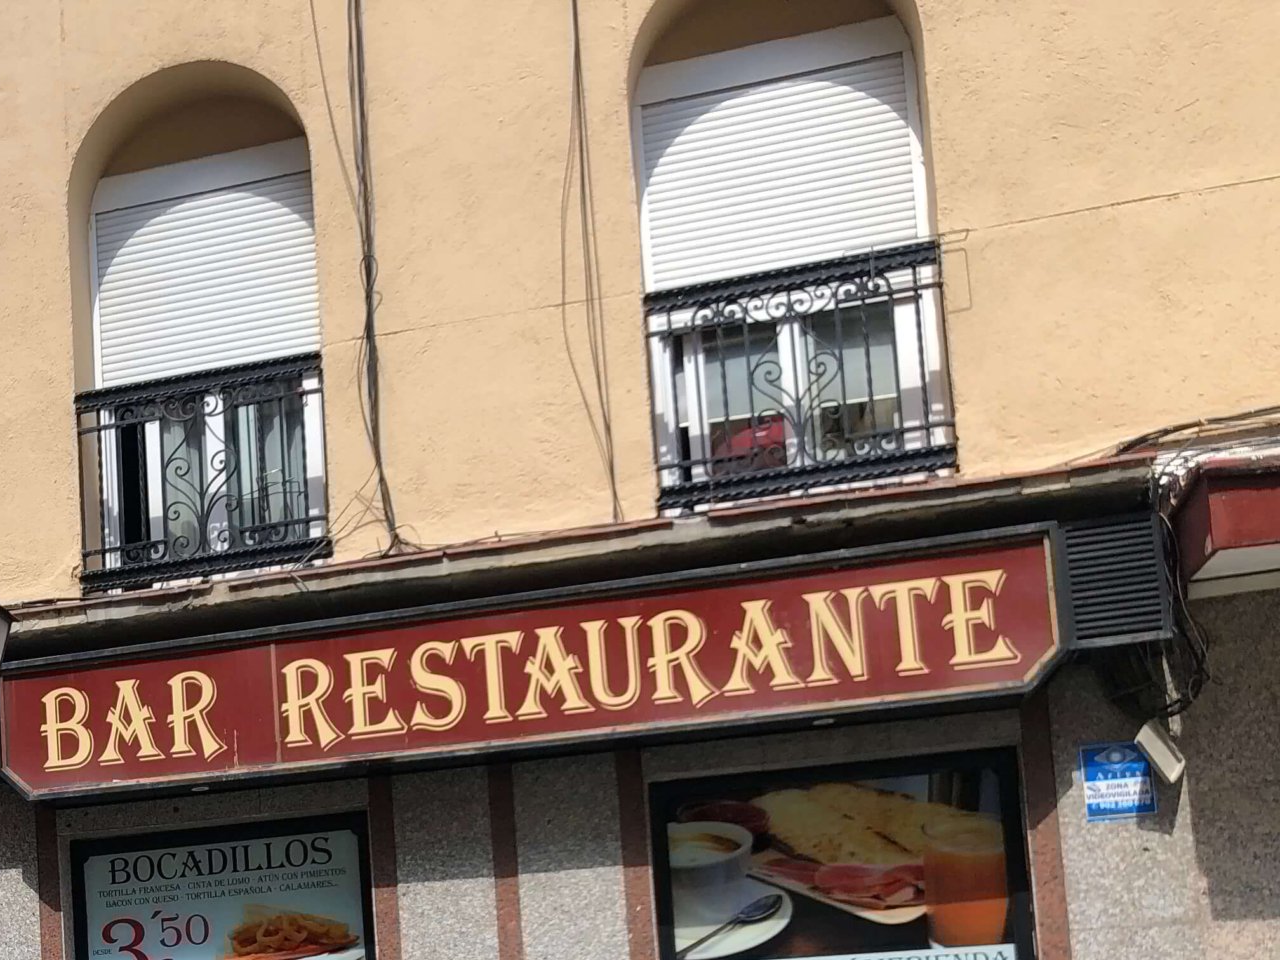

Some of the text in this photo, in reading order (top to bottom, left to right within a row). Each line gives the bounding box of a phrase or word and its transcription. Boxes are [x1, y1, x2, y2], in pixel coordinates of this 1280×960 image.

[40, 568, 1022, 774] BAR RESTAURANTE
[109, 836, 333, 885] BOCADILLOS
[97, 888, 137, 898] TORTILLA
[138, 883, 181, 894] FRANCESA
[187, 880, 212, 890] CINTA
[214, 878, 225, 887] DE
[227, 877, 250, 886] LOMO
[281, 871, 298, 881] CON
[300, 867, 347, 879] PIMIENTOS
[134, 898, 150, 906] CON
[152, 895, 179, 904] QUESO
[185, 890, 226, 901] TORTILLA
[228, 886, 272, 897] ESPAÑOLA
